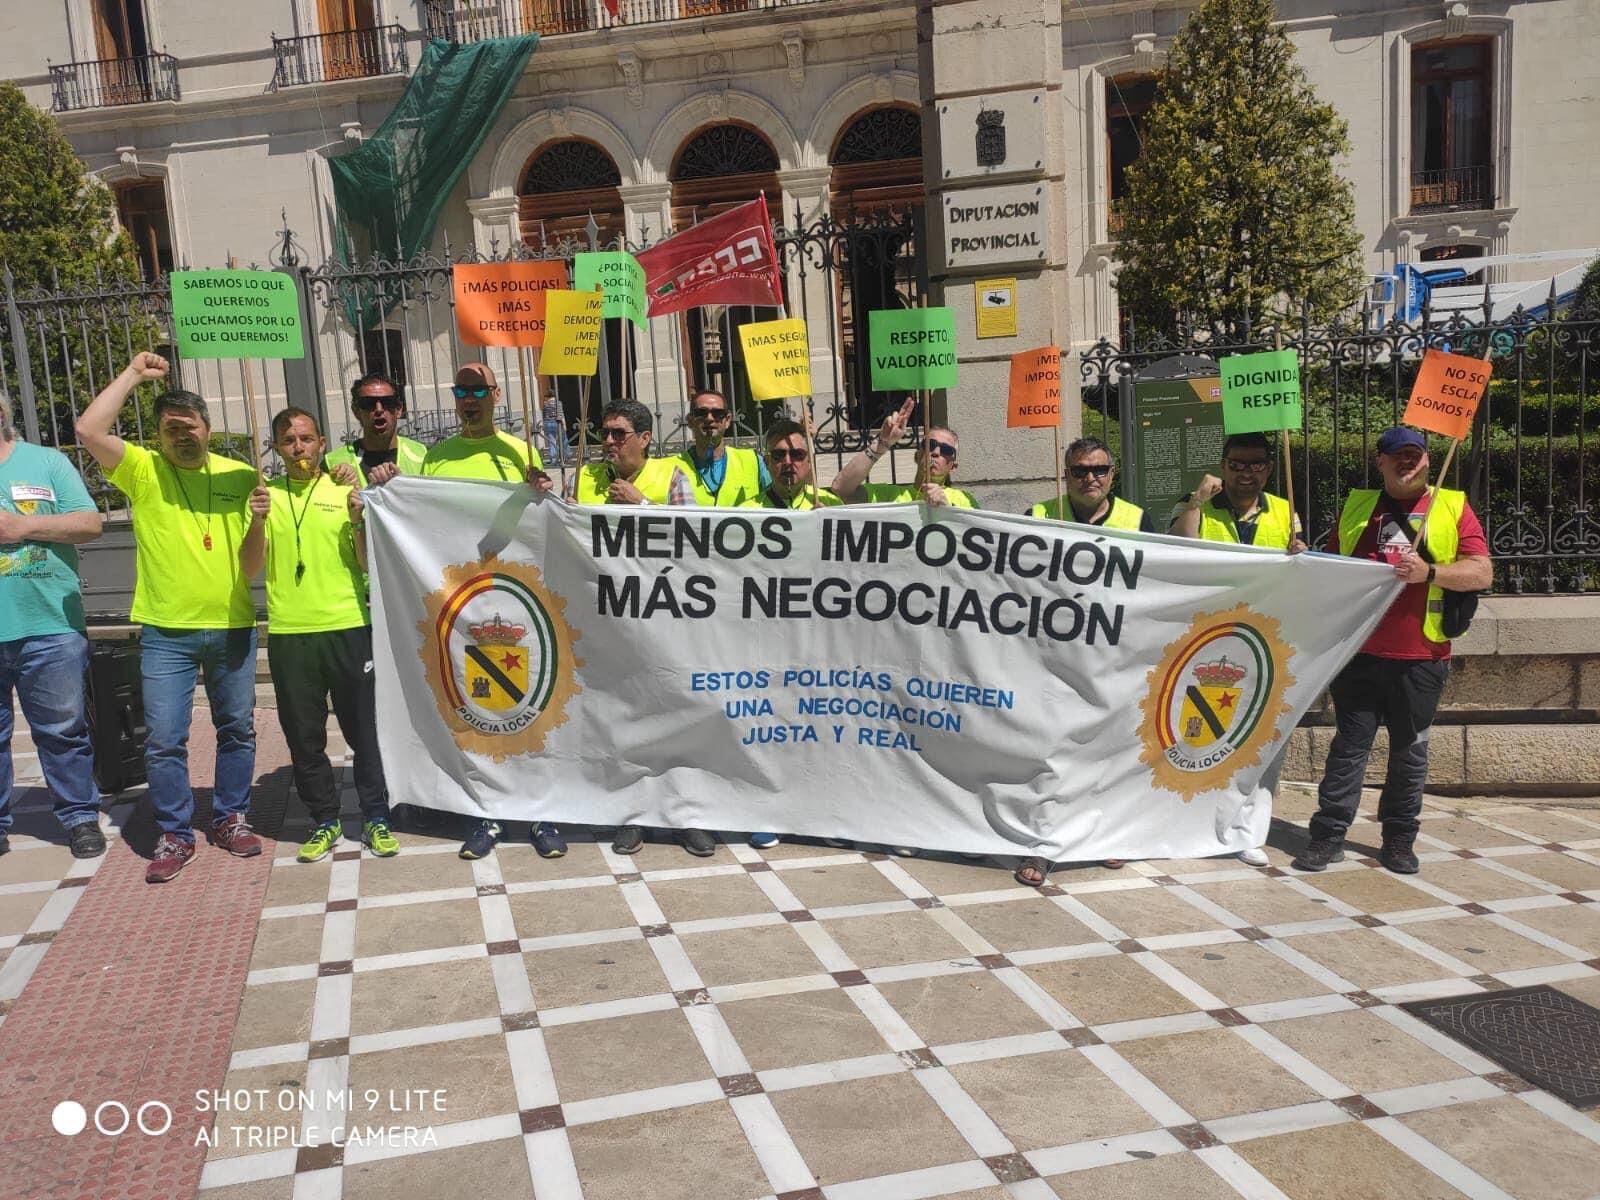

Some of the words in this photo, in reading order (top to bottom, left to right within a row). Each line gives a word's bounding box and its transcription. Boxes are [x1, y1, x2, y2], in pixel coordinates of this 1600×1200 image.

[950, 201, 1039, 223] DIPUTACION
[951, 231, 1040, 253] PROVINCIAL
[183, 279, 242, 290] SABEMOS
[245, 279, 258, 289] LO
[261, 280, 285, 291] QUE
[463, 278, 497, 293] ¡MÁS
[203, 296, 270, 307] QUEREMOS
[498, 299, 531, 313] ¡MÁS
[180, 315, 253, 327] ¡LUCHAMOS
[256, 316, 277, 326] POR
[281, 317, 295, 326] LO
[479, 319, 545, 332] DERECHOS
[564, 315, 600, 325] DEMOC
[190, 332, 216, 342] QUE
[220, 332, 289, 342] QUEREMOS!
[890, 329, 950, 345] RESPETO,
[772, 351, 779, 360] Y
[1445, 367, 1466, 380] NO
[1242, 391, 1298, 409] RESPET
[1440, 384, 1478, 401] ESCLA
[1415, 396, 1463, 416] SOMOS
[591, 514, 793, 560] MENOS
[820, 518, 1144, 590] IMPOSICIÓN
[597, 566, 717, 619] MÁS
[742, 576, 1125, 646] NEGOCIACIÓN
[691, 670, 770, 692] ESTOS
[783, 665, 893, 691] POLICÍAS
[906, 677, 1015, 709] QUIEREN
[502, 710, 537, 732] LOCAL
[726, 698, 774, 719] UNA
[798, 698, 962, 733] NEGOCIACIÓN
[742, 725, 818, 745] JUSTA
[832, 725, 845, 743] Y
[858, 727, 923, 751] REAL
[1198, 746, 1233, 769] LOCAL
